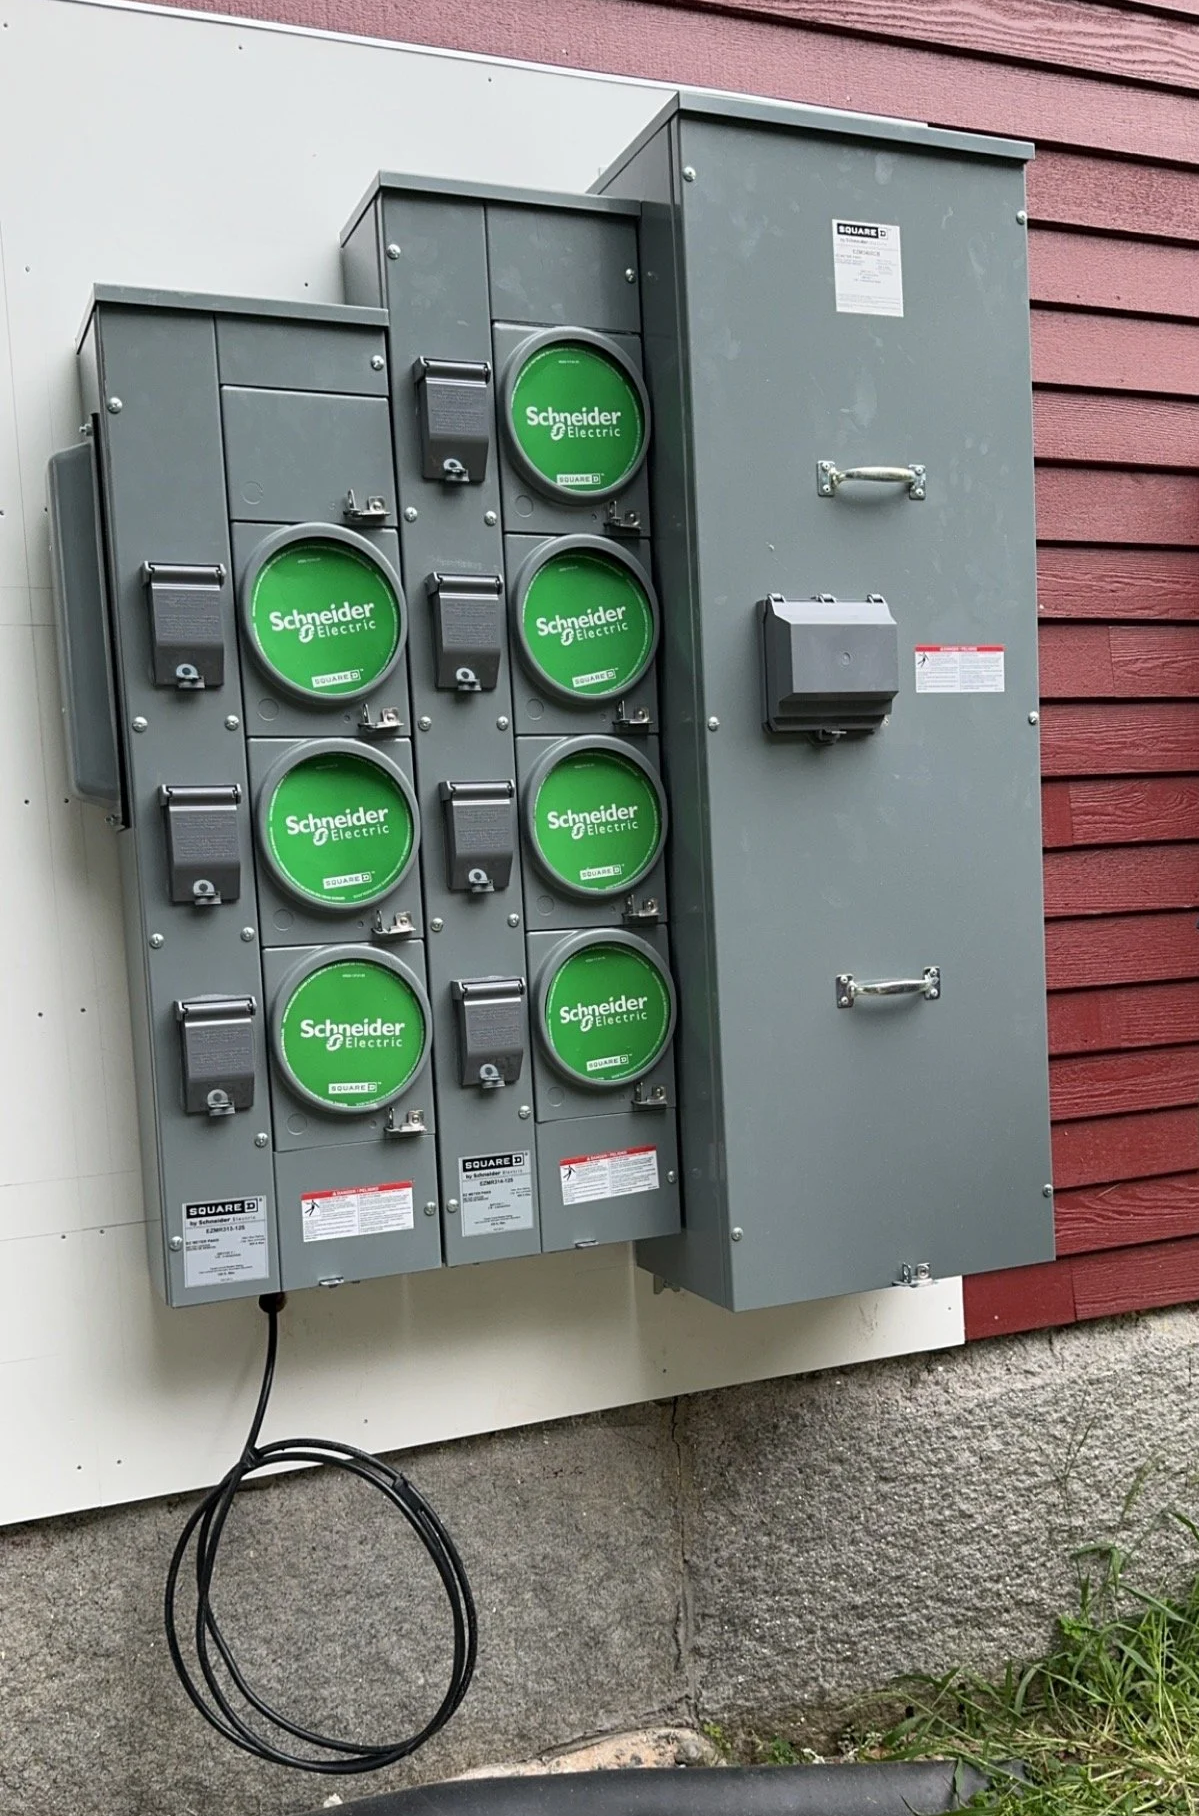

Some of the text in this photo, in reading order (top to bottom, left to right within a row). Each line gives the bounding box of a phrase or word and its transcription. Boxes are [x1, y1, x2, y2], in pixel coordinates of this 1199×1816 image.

[838, 225, 877, 237] SQUARE
[526, 406, 622, 426] Schneider
[568, 426, 621, 438] Electric
[559, 474, 590, 484] SQUARE
[269, 602, 375, 632] Schneider
[536, 606, 626, 636] Schneider
[316, 619, 376, 638] Electric
[576, 621, 629, 641] Electric
[314, 674, 350, 685] SQUARE
[574, 674, 606, 685] SQUARE
[286, 806, 388, 836] Schneider
[547, 803, 638, 829] Schneider
[331, 824, 390, 842] Electric
[586, 820, 638, 836] Electric
[582, 868, 612, 878] SQUARE
[325, 876, 360, 887] SQUARE
[560, 994, 648, 1024] Schneider
[596, 1011, 648, 1028] Electric
[300, 1018, 406, 1038] Schneider
[346, 1036, 403, 1048] Electric
[588, 1058, 620, 1070] SQUARE
[330, 1084, 368, 1092] SQUARE
[465, 1157, 511, 1169] SQUARE
[189, 1203, 242, 1216] SQUARE
[198, 1217, 230, 1226] Schneider
